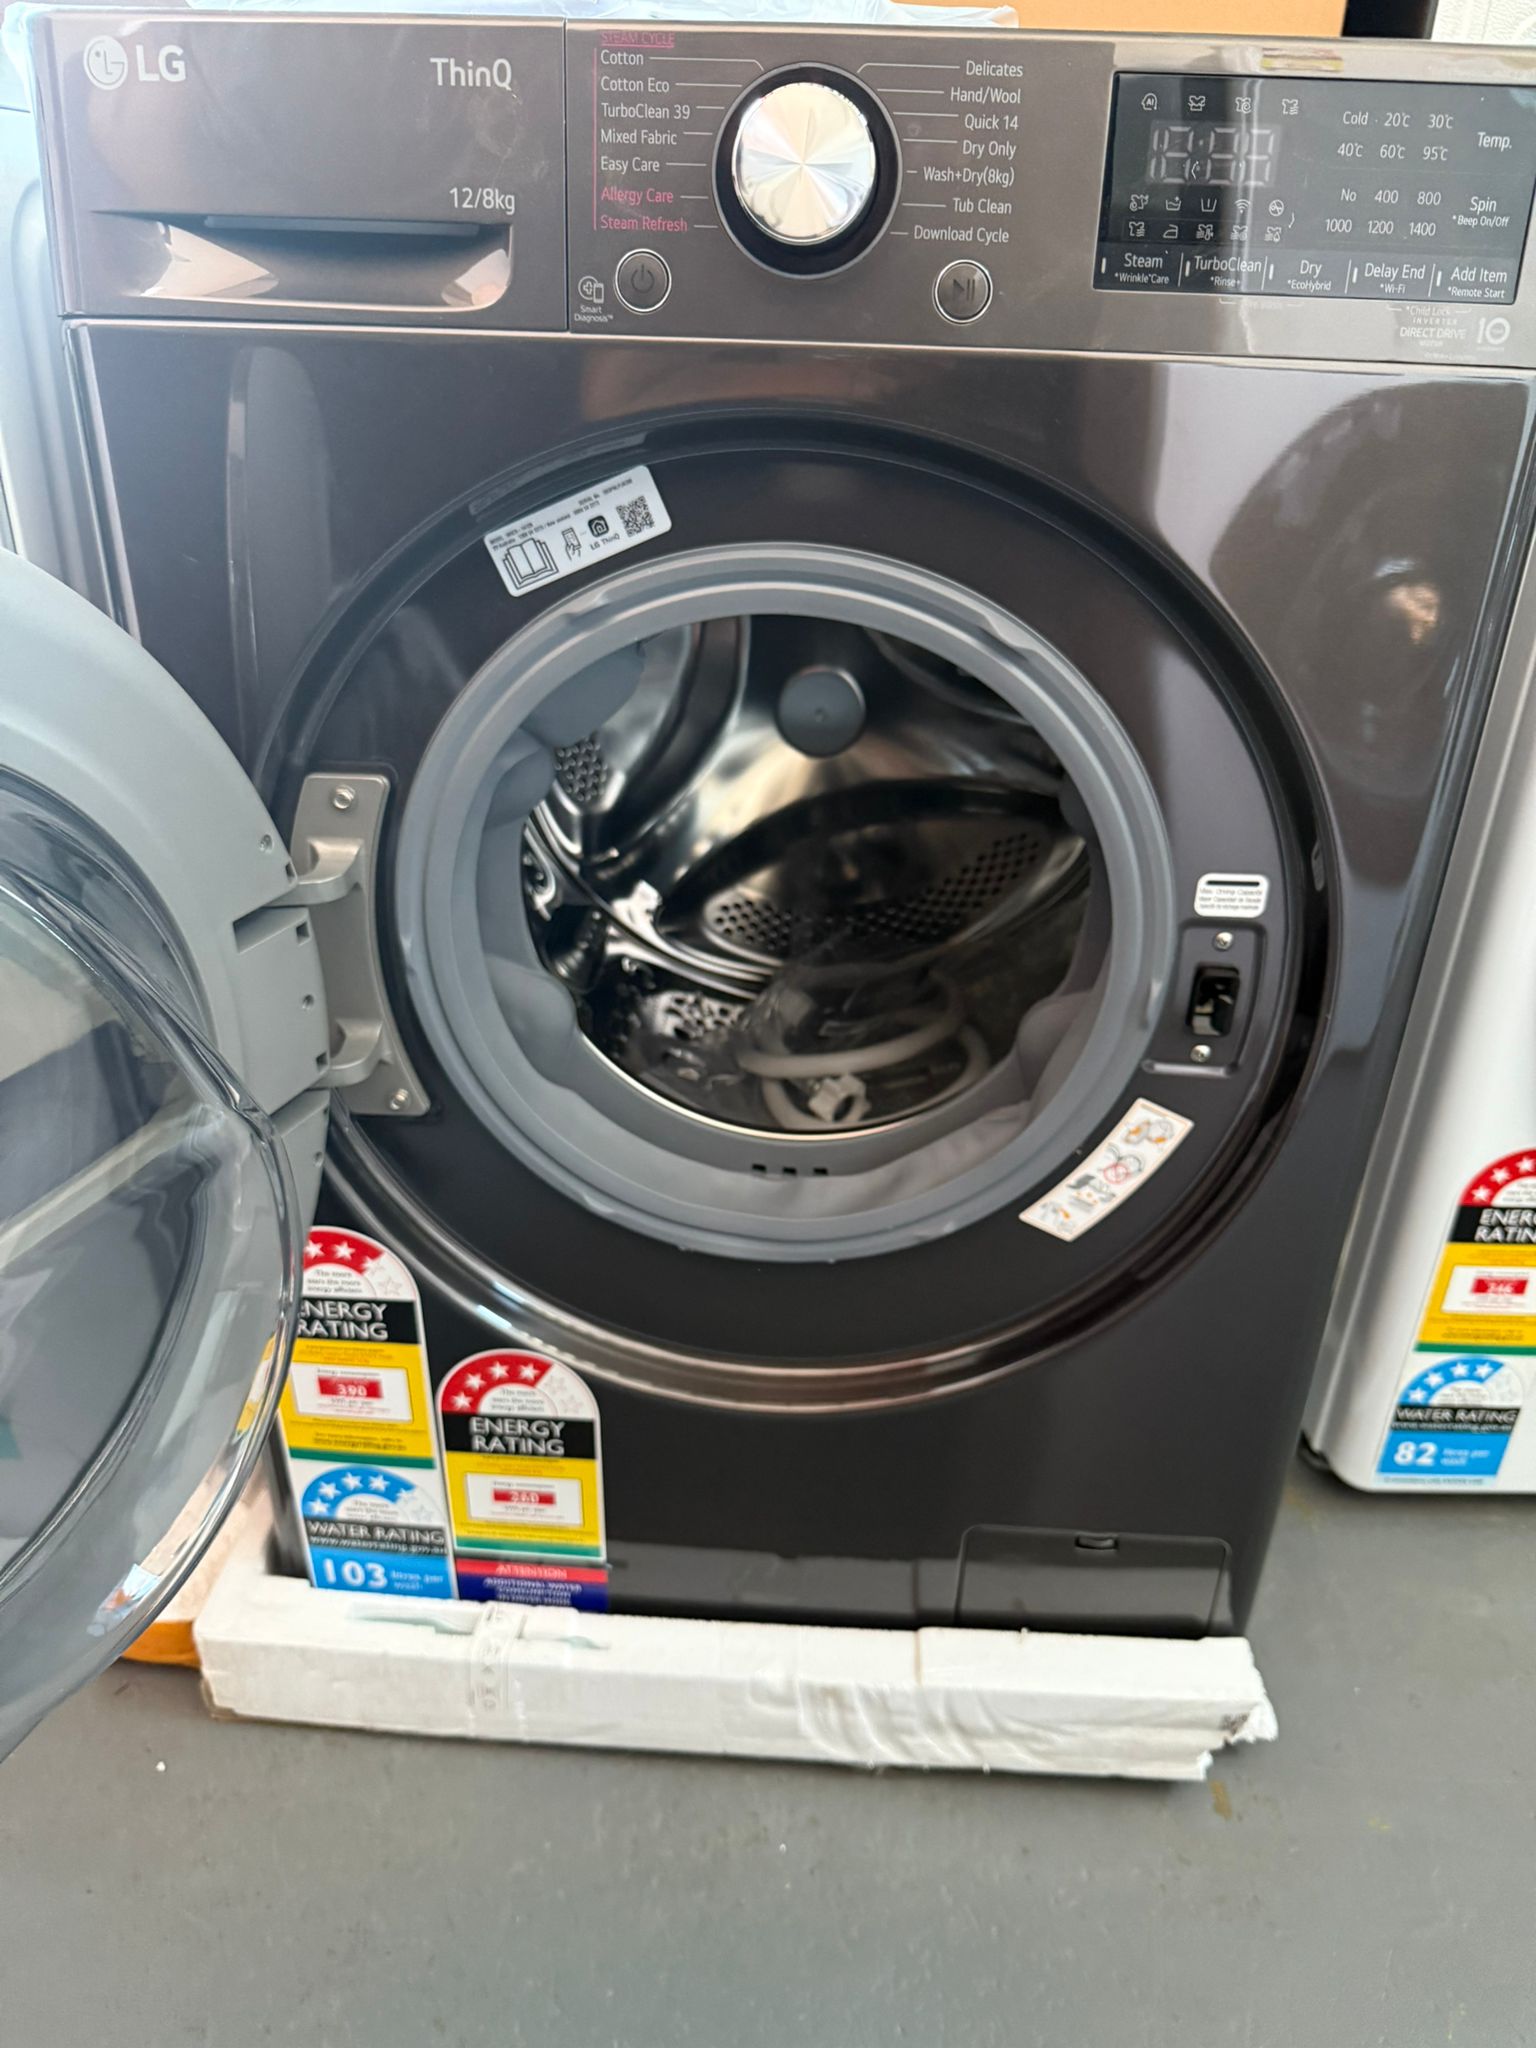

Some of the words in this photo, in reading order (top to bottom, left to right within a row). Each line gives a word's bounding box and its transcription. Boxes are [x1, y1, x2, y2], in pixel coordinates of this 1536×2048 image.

[600, 32, 638, 45] STEAM
[641, 33, 675, 46] CYCLE
[135, 44, 187, 82] LG
[600, 50, 644, 66] Cotton
[429, 57, 512, 91] ThinQ
[966, 60, 1024, 78] Delicates
[600, 76, 644, 92] Cotton
[647, 78, 670, 93] Eco
[950, 87, 1022, 105] Hand/Wool
[601, 103, 670, 119] TurboClean
[673, 104, 691, 120] 39
[1343, 111, 1369, 126] Cold
[964, 113, 1000, 131] Quick
[1003, 115, 1020, 131] 14
[601, 130, 637, 145] Mixed
[641, 130, 678, 146] Fabric
[1477, 132, 1513, 152] Temp.
[963, 140, 985, 159] Dry
[988, 141, 1017, 160] Only
[601, 156, 629, 175] Easy
[632, 157, 661, 172] Care
[923, 166, 1016, 187] Wash+Dry(8kg)
[449, 187, 516, 216] 12/8kg
[601, 187, 643, 206] Allergy
[646, 188, 674, 203] Care
[1340, 188, 1357, 202] No
[1374, 190, 1399, 205] 400
[1417, 191, 1442, 206] 800
[952, 198, 975, 214] Tub
[978, 199, 1013, 215] Clean
[1470, 196, 1497, 218] Spin
[600, 215, 639, 231] Steam
[642, 216, 689, 233] Refresh
[1325, 218, 1352, 233] 1000
[1367, 220, 1394, 235] 1200
[1409, 222, 1436, 237] 1400
[1457, 215, 1479, 229] Beep
[1480, 216, 1509, 228] On/Off
[914, 225, 974, 242] Download
[976, 227, 1010, 246] Cycle
[1123, 252, 1163, 269] Steam
[1194, 255, 1262, 273] TurboClean
[1300, 259, 1323, 279] Dry
[1150, 273, 1170, 285] Care
[1364, 262, 1399, 282] Delay
[1402, 264, 1426, 280] End
[1450, 266, 1476, 282] Add
[1479, 268, 1508, 284] Item
[1484, 288, 1505, 299] Start
[580, 304, 602, 314] Smart
[1399, 327, 1436, 339] DIRECT
[1436, 328, 1467, 340] DRIVE
[589, 539, 601, 551] LG
[1479, 1208, 1536, 1227] ENER
[298, 1319, 389, 1341] RATING
[1395, 1408, 1453, 1421] WATER
[1455, 1409, 1519, 1424] RATING
[469, 1415, 566, 1438] ENERGY
[471, 1435, 565, 1457] RATING
[1393, 1441, 1437, 1466] 82
[307, 1520, 371, 1540] WATER
[375, 1526, 446, 1546] RATING
[322, 1557, 388, 1590] 103
